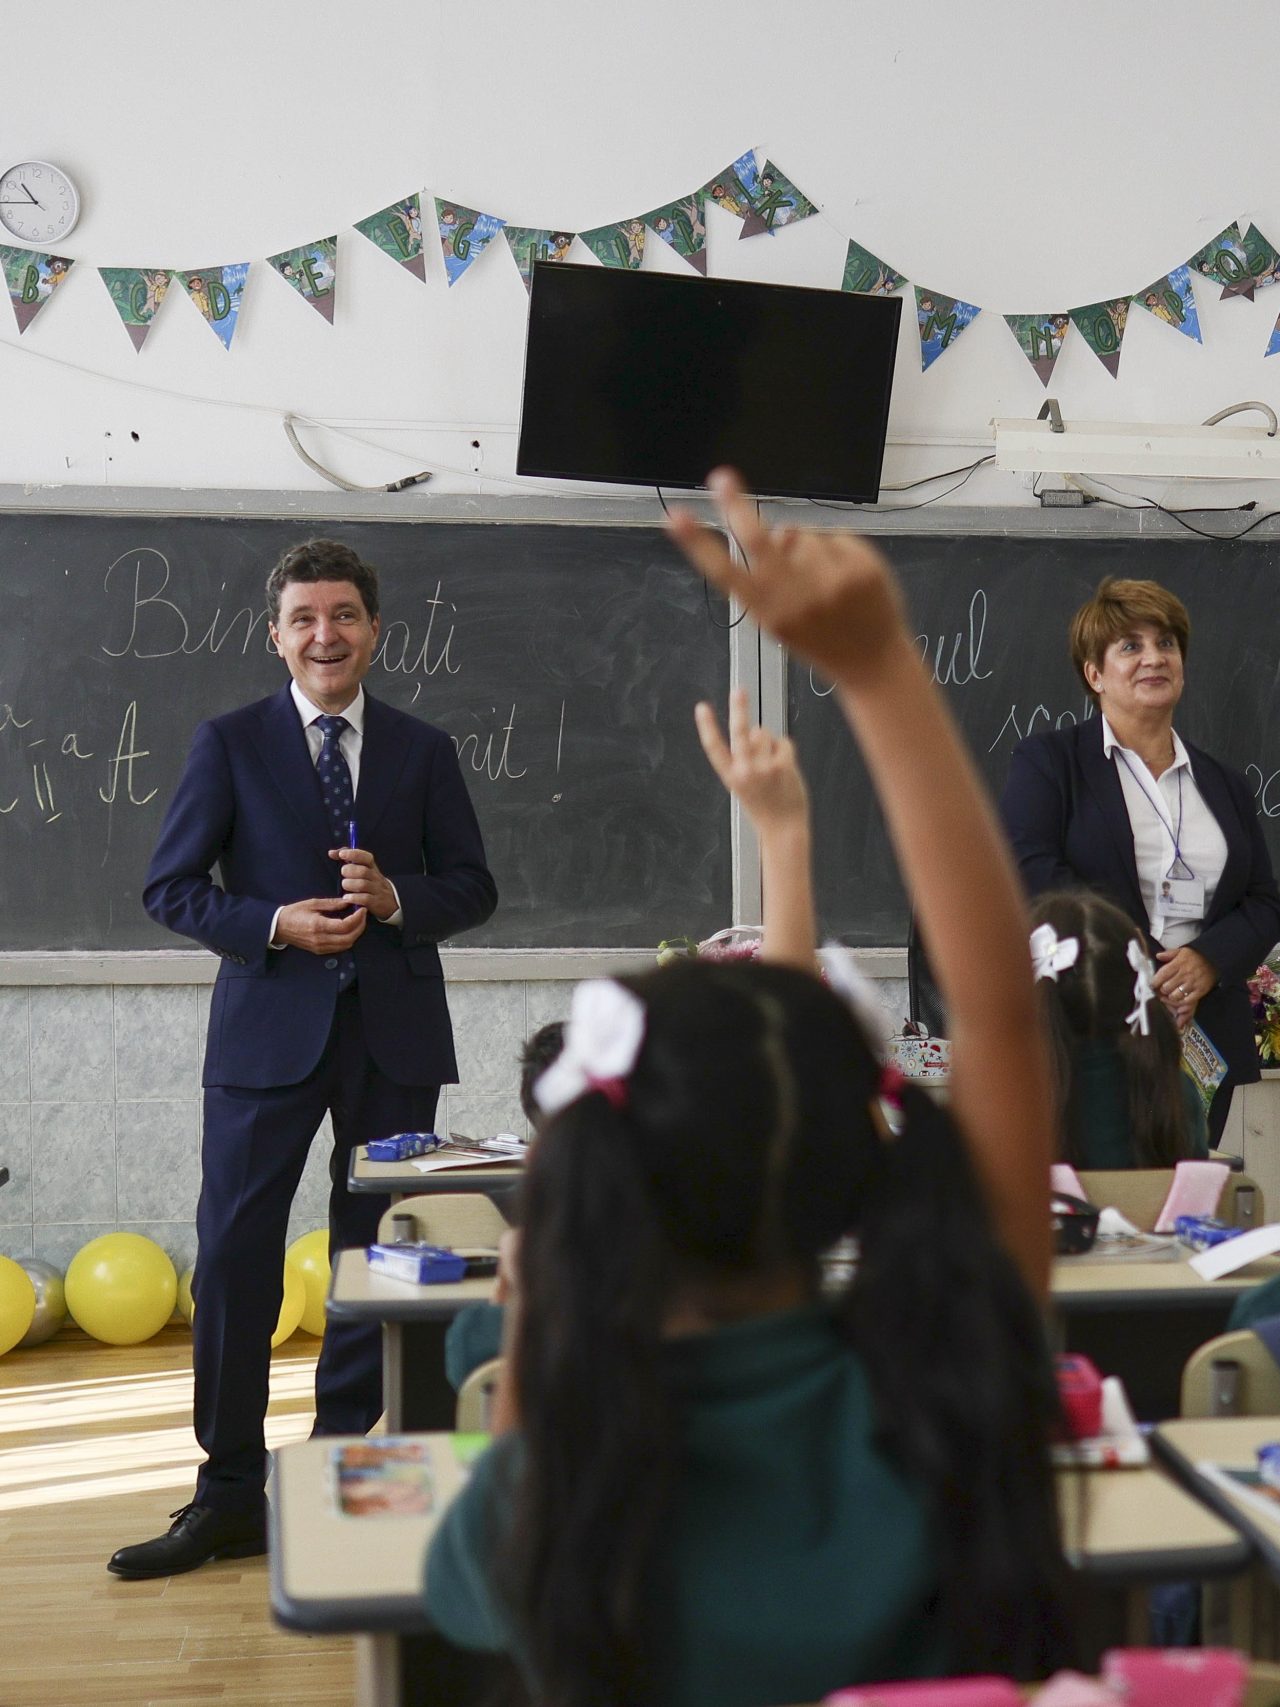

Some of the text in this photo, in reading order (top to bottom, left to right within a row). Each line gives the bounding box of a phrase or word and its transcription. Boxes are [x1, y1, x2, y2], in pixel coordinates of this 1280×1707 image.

[33, 168, 41, 179] 12
[22, 264, 39, 304] B
[130, 282, 149, 321] C
[207, 281, 231, 321] D
[301, 257, 329, 298] E
[387, 218, 410, 258] F
[453, 222, 474, 261] G
[755, 189, 793, 228] K
[922, 313, 958, 349] M
[1030, 325, 1053, 361] N
[1093, 313, 1117, 351] O
[1163, 290, 1186, 322] P
[1215, 249, 1250, 282] Q
[101, 548, 276, 659] Bin
[450, 703, 527, 781] nit
